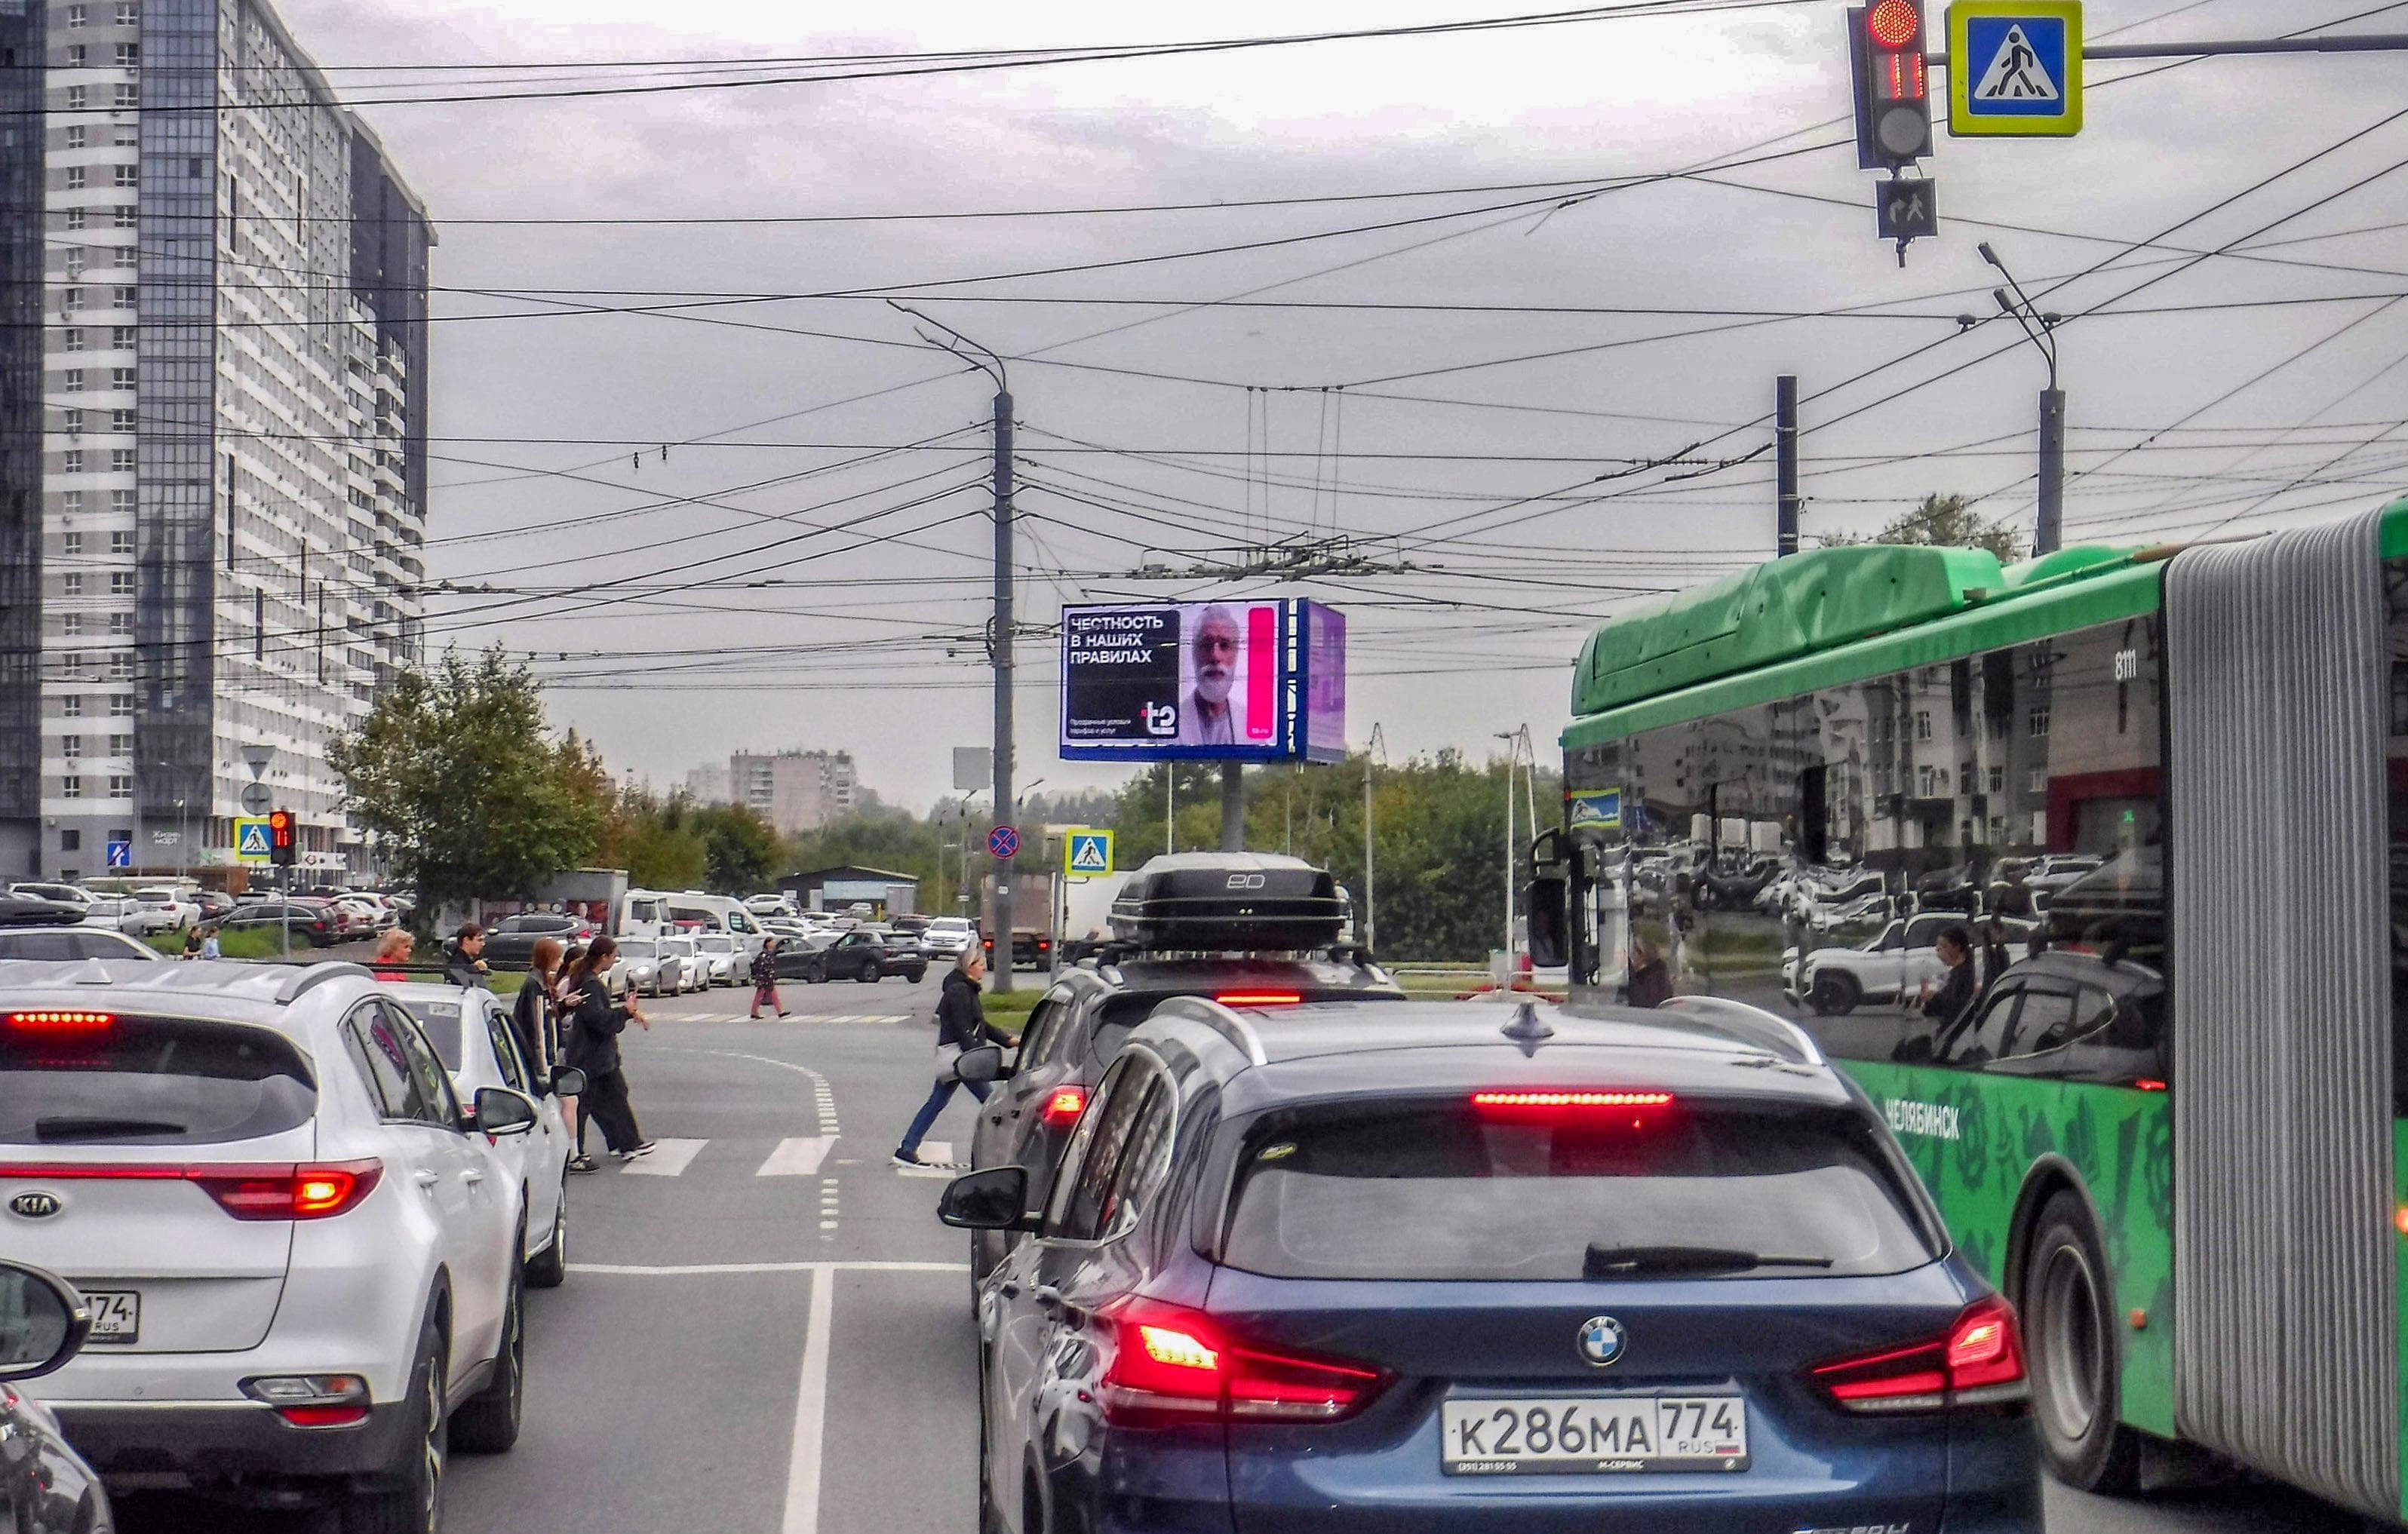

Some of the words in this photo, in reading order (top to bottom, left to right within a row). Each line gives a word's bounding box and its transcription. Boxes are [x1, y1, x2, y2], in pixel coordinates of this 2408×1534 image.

[1071, 615, 1163, 630] ЧЕСТНОСТЬ
[1071, 635, 1081, 647] В
[1086, 633, 1143, 646] НАШИХ
[1070, 649, 1152, 664] ПРАВИЛАХ
[2115, 649, 2136, 680] 8111
[1143, 701, 1175, 735] t2
[1886, 1098, 1960, 1140] ЧЕЛЯБИНСК
[17, 1197, 51, 1213] KIA
[95, 1322, 119, 1331] RUS
[1662, 1401, 1733, 1439] 774
[1679, 1440, 1713, 1454] RUS
